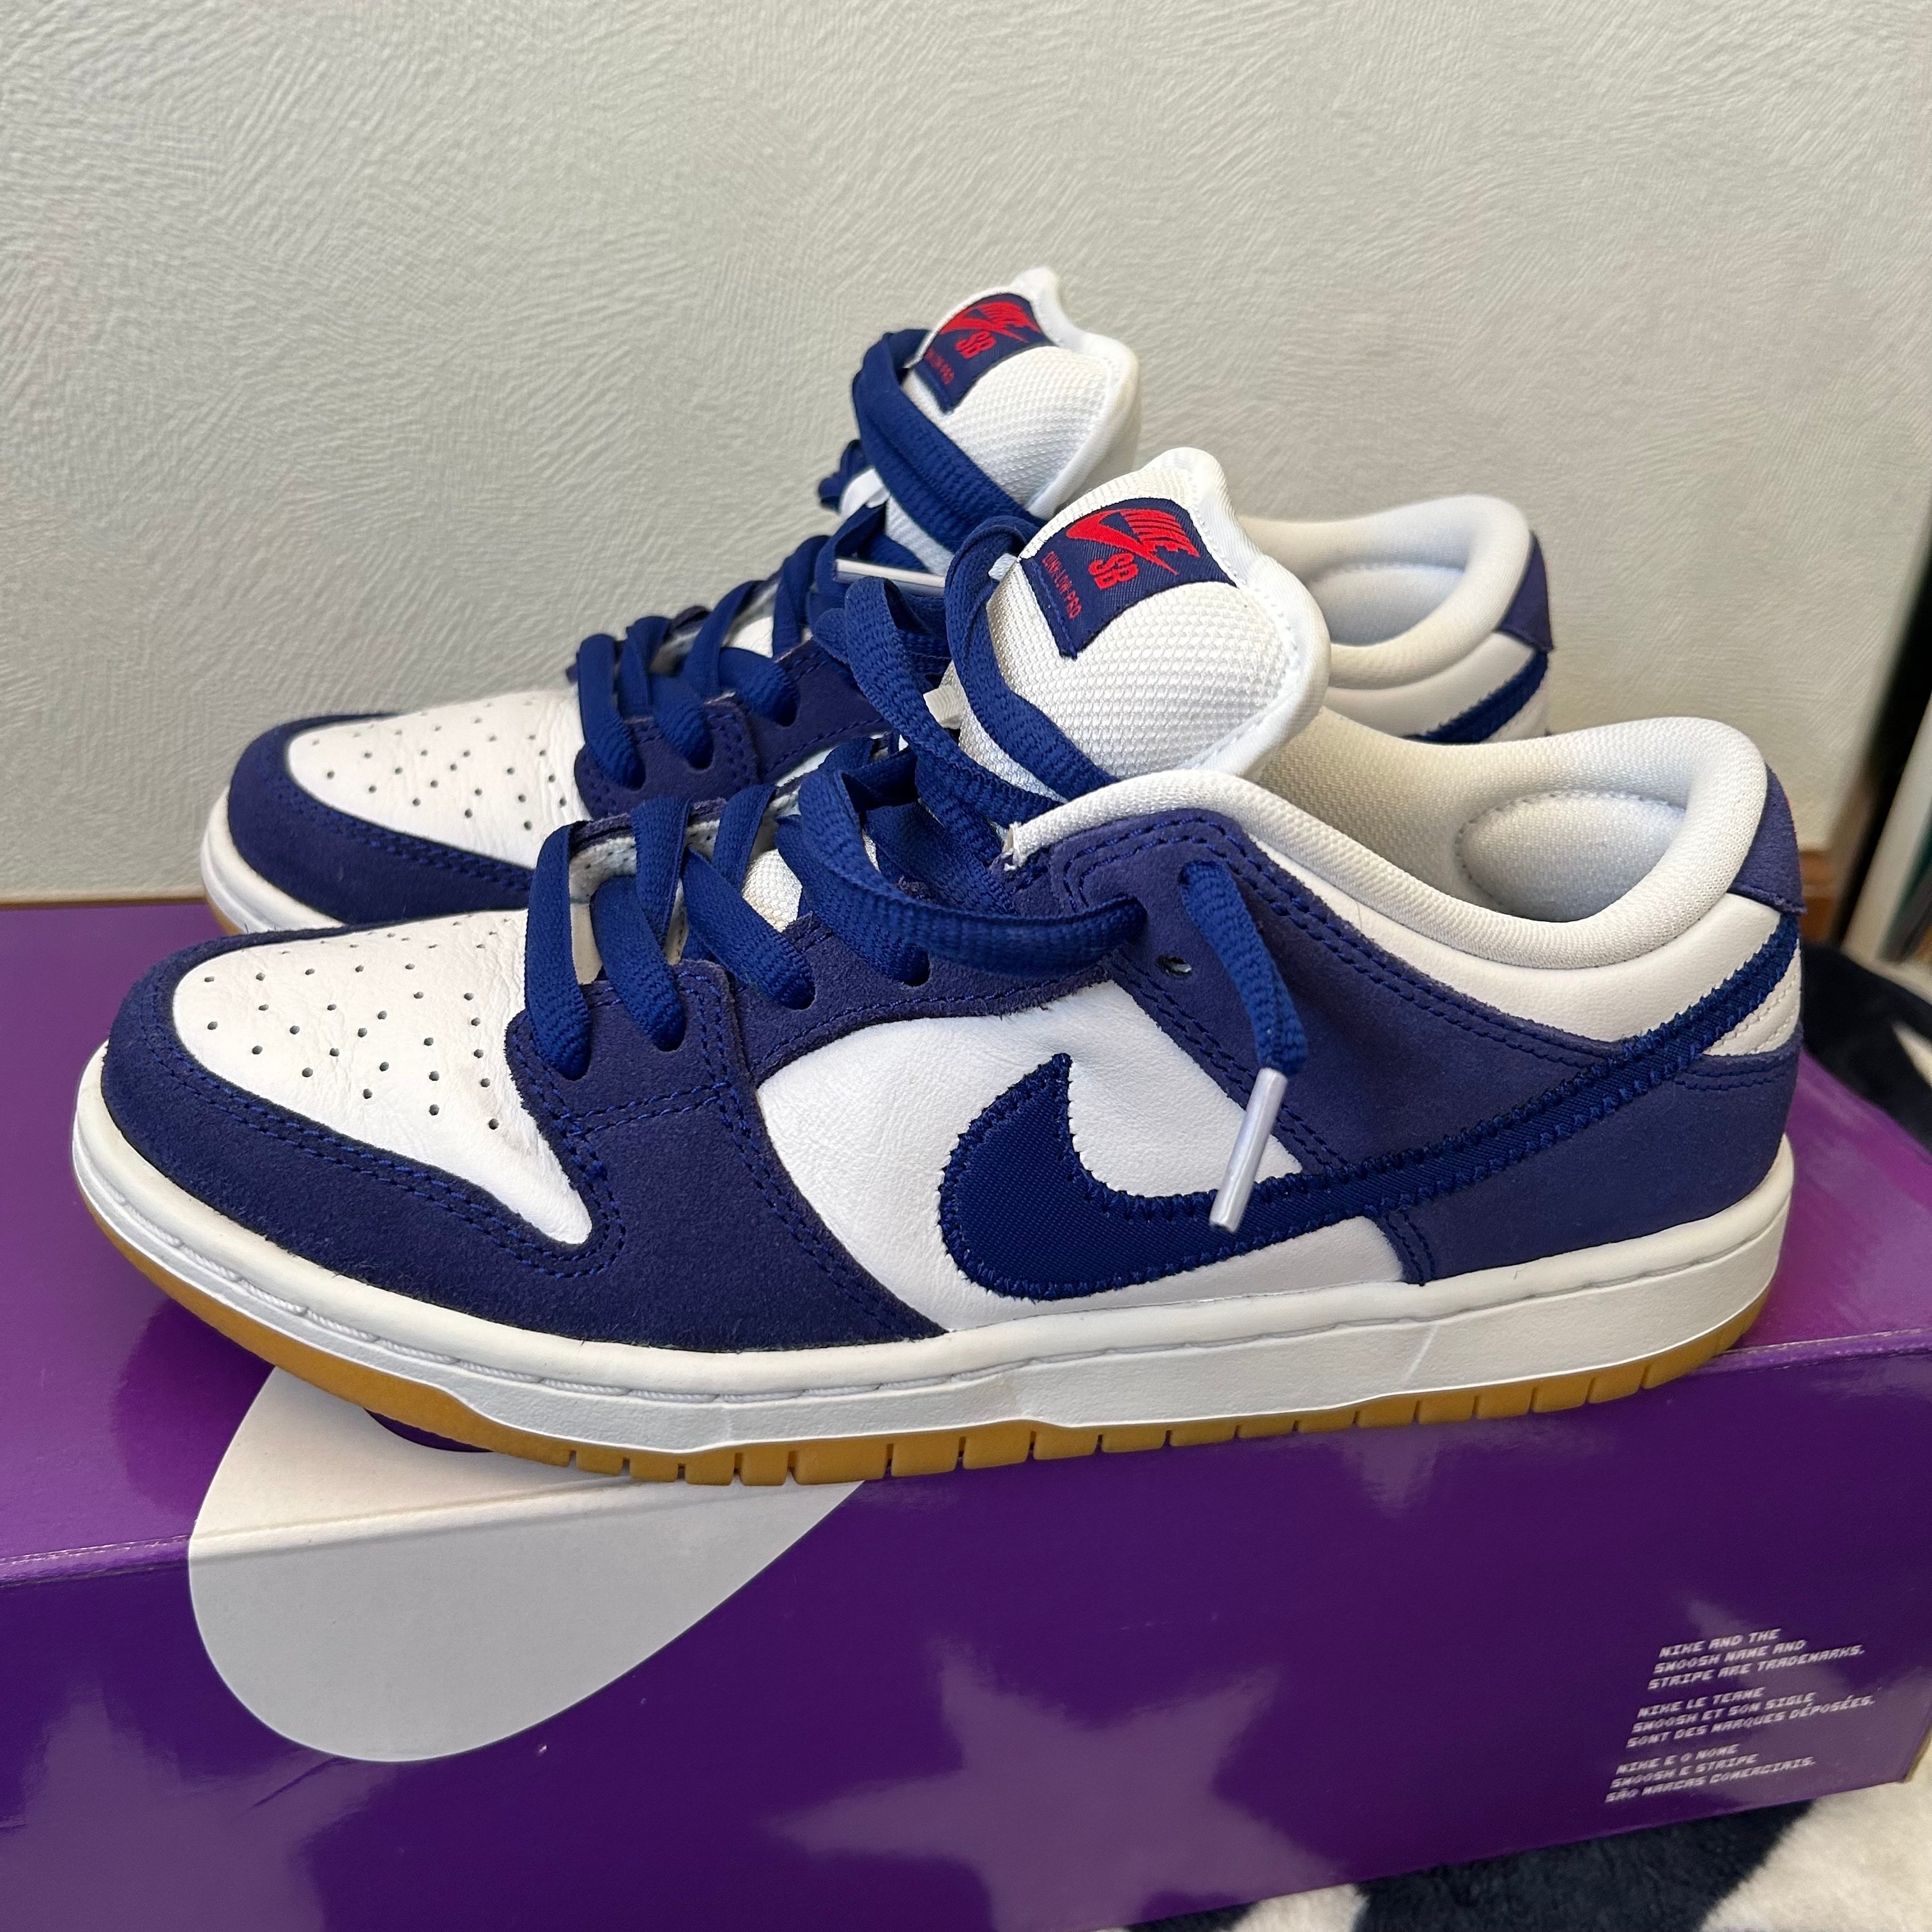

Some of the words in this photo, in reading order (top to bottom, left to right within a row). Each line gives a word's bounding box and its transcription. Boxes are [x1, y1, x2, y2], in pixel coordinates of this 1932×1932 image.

[955, 330, 997, 359] SB
[1119, 509, 1201, 557] NIKE
[1088, 553, 1138, 590] SB
[1063, 589, 1082, 620] PRO
[1653, 1653, 1722, 1675] SWOOSH
[1724, 1645, 1770, 1662] NAME
[1772, 1639, 1807, 1654] AND
[1659, 1641, 1706, 1658] NIKE
[1708, 1634, 1744, 1650] AND
[1749, 1628, 1781, 1643] THE
[1648, 1669, 1716, 1690] STRIPE
[1717, 1662, 1752, 1678] ARE
[1758, 1644, 1866, 1671] TRADEMARKS.
[1626, 1731, 1672, 1748] SONT
[1673, 1725, 1709, 1740] DES
[1710, 1711, 1788, 1733] MARQUES
[1788, 1694, 1875, 1719] DÉPOSÉES.
[1631, 1712, 1700, 1733] SWOOSH
[1701, 1708, 1726, 1721] ET
[1728, 1702, 1761, 1716] SON
[1764, 1692, 1817, 1710] SIGLE
[1637, 1701, 1683, 1719] NIKE
[1686, 1696, 1708, 1709] LE
[1712, 1687, 1767, 1705] TERME
[1610, 1768, 1678, 1789] SWOOSH
[1678, 1765, 1693, 1776] E
[1694, 1754, 1759, 1774] STRIPE
[1616, 1758, 1662, 1775] NIKE
[1664, 1755, 1678, 1766] E
[1680, 1752, 1692, 1762] O
[1695, 1744, 1740, 1760] NOME
[1641, 1775, 1708, 1796] MARCAS
[1709, 1756, 1817, 1784] COMERCIAIS.
